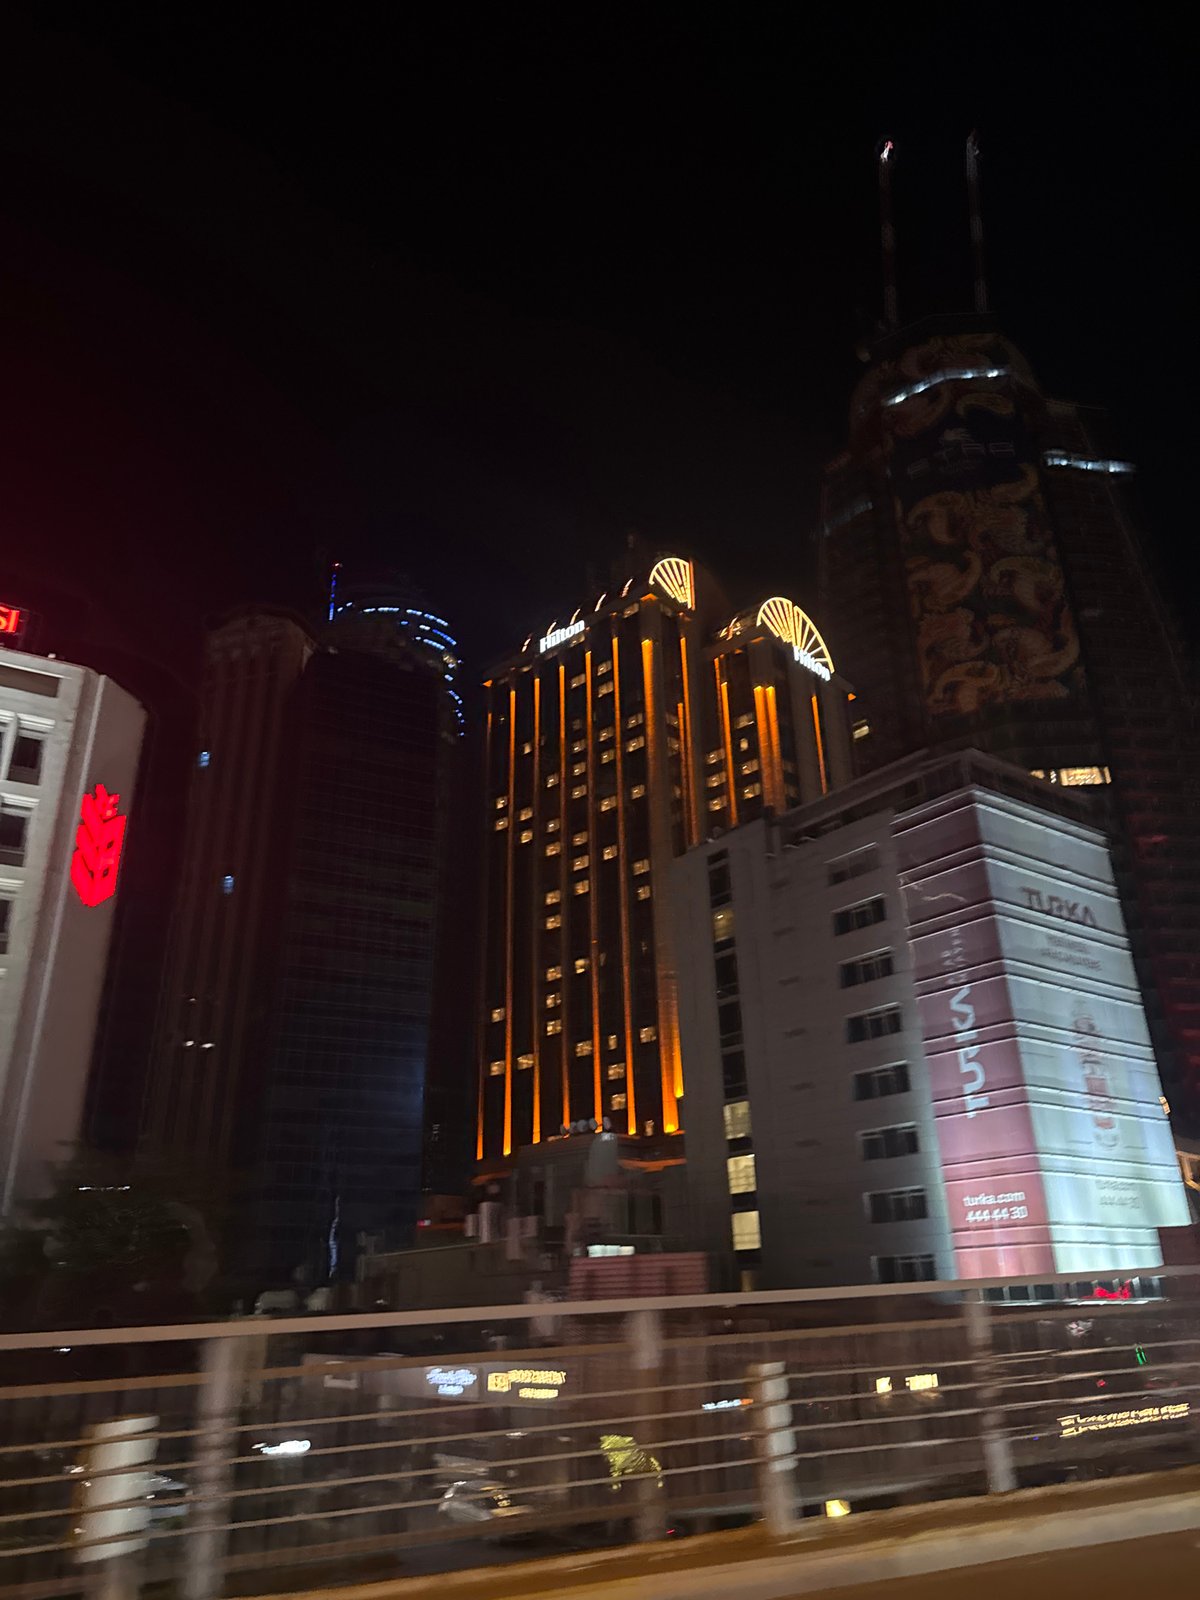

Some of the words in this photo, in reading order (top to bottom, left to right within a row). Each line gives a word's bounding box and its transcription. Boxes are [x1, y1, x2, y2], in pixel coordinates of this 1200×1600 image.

[539, 619, 586, 654] Hilton
[793, 645, 831, 682] Hilton
[1018, 886, 1097, 928] TURKA
[962, 1191, 1026, 1208] turka.com
[965, 1209, 991, 1223] 444
[991, 1207, 1010, 1221] 44
